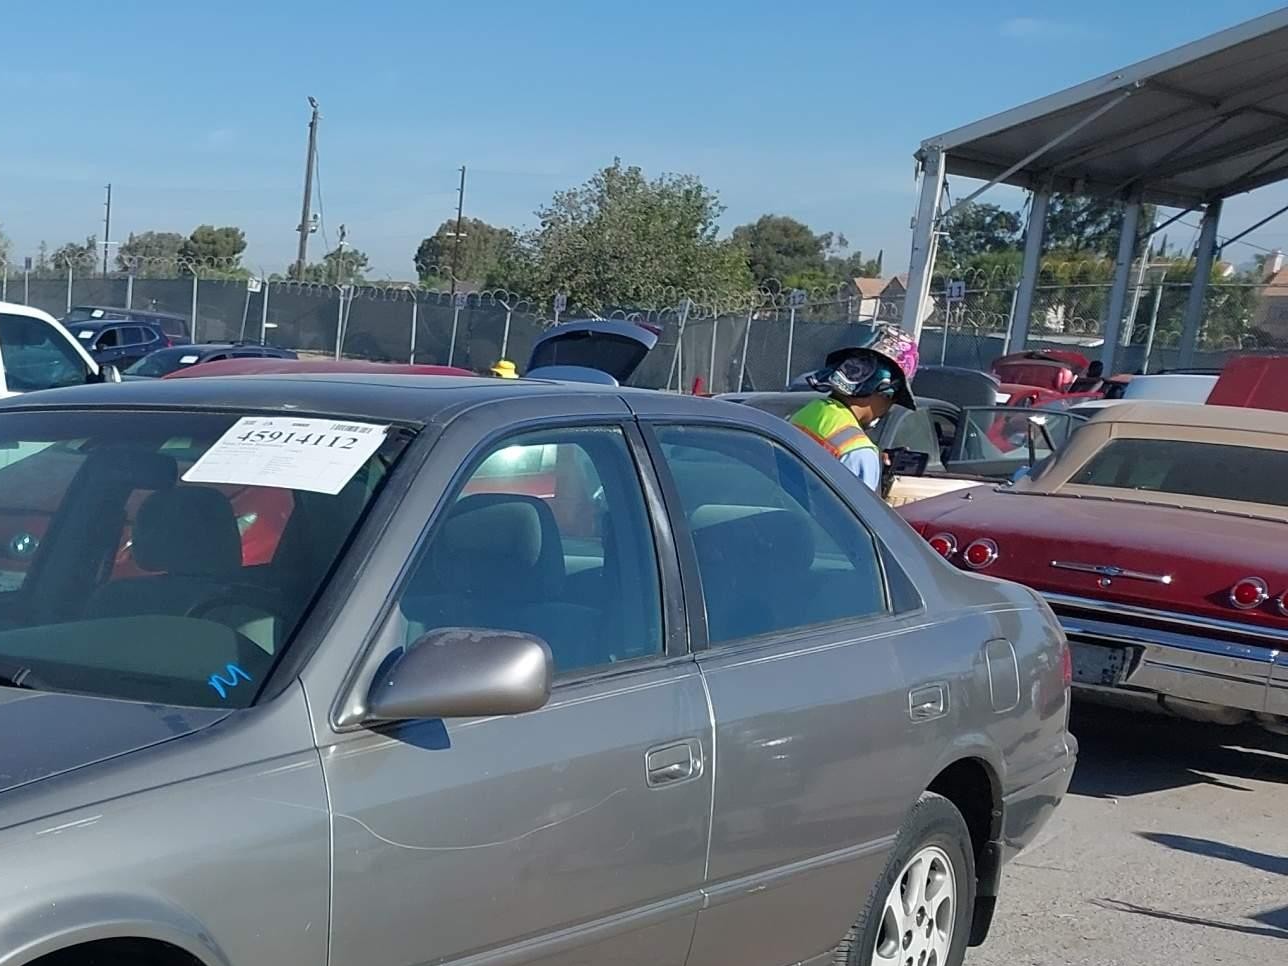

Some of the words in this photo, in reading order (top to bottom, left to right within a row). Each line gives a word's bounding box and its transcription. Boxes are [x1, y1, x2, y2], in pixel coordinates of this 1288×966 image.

[948, 285, 962, 298] 11
[792, 294, 805, 306] 12
[237, 430, 359, 450] 45914112
